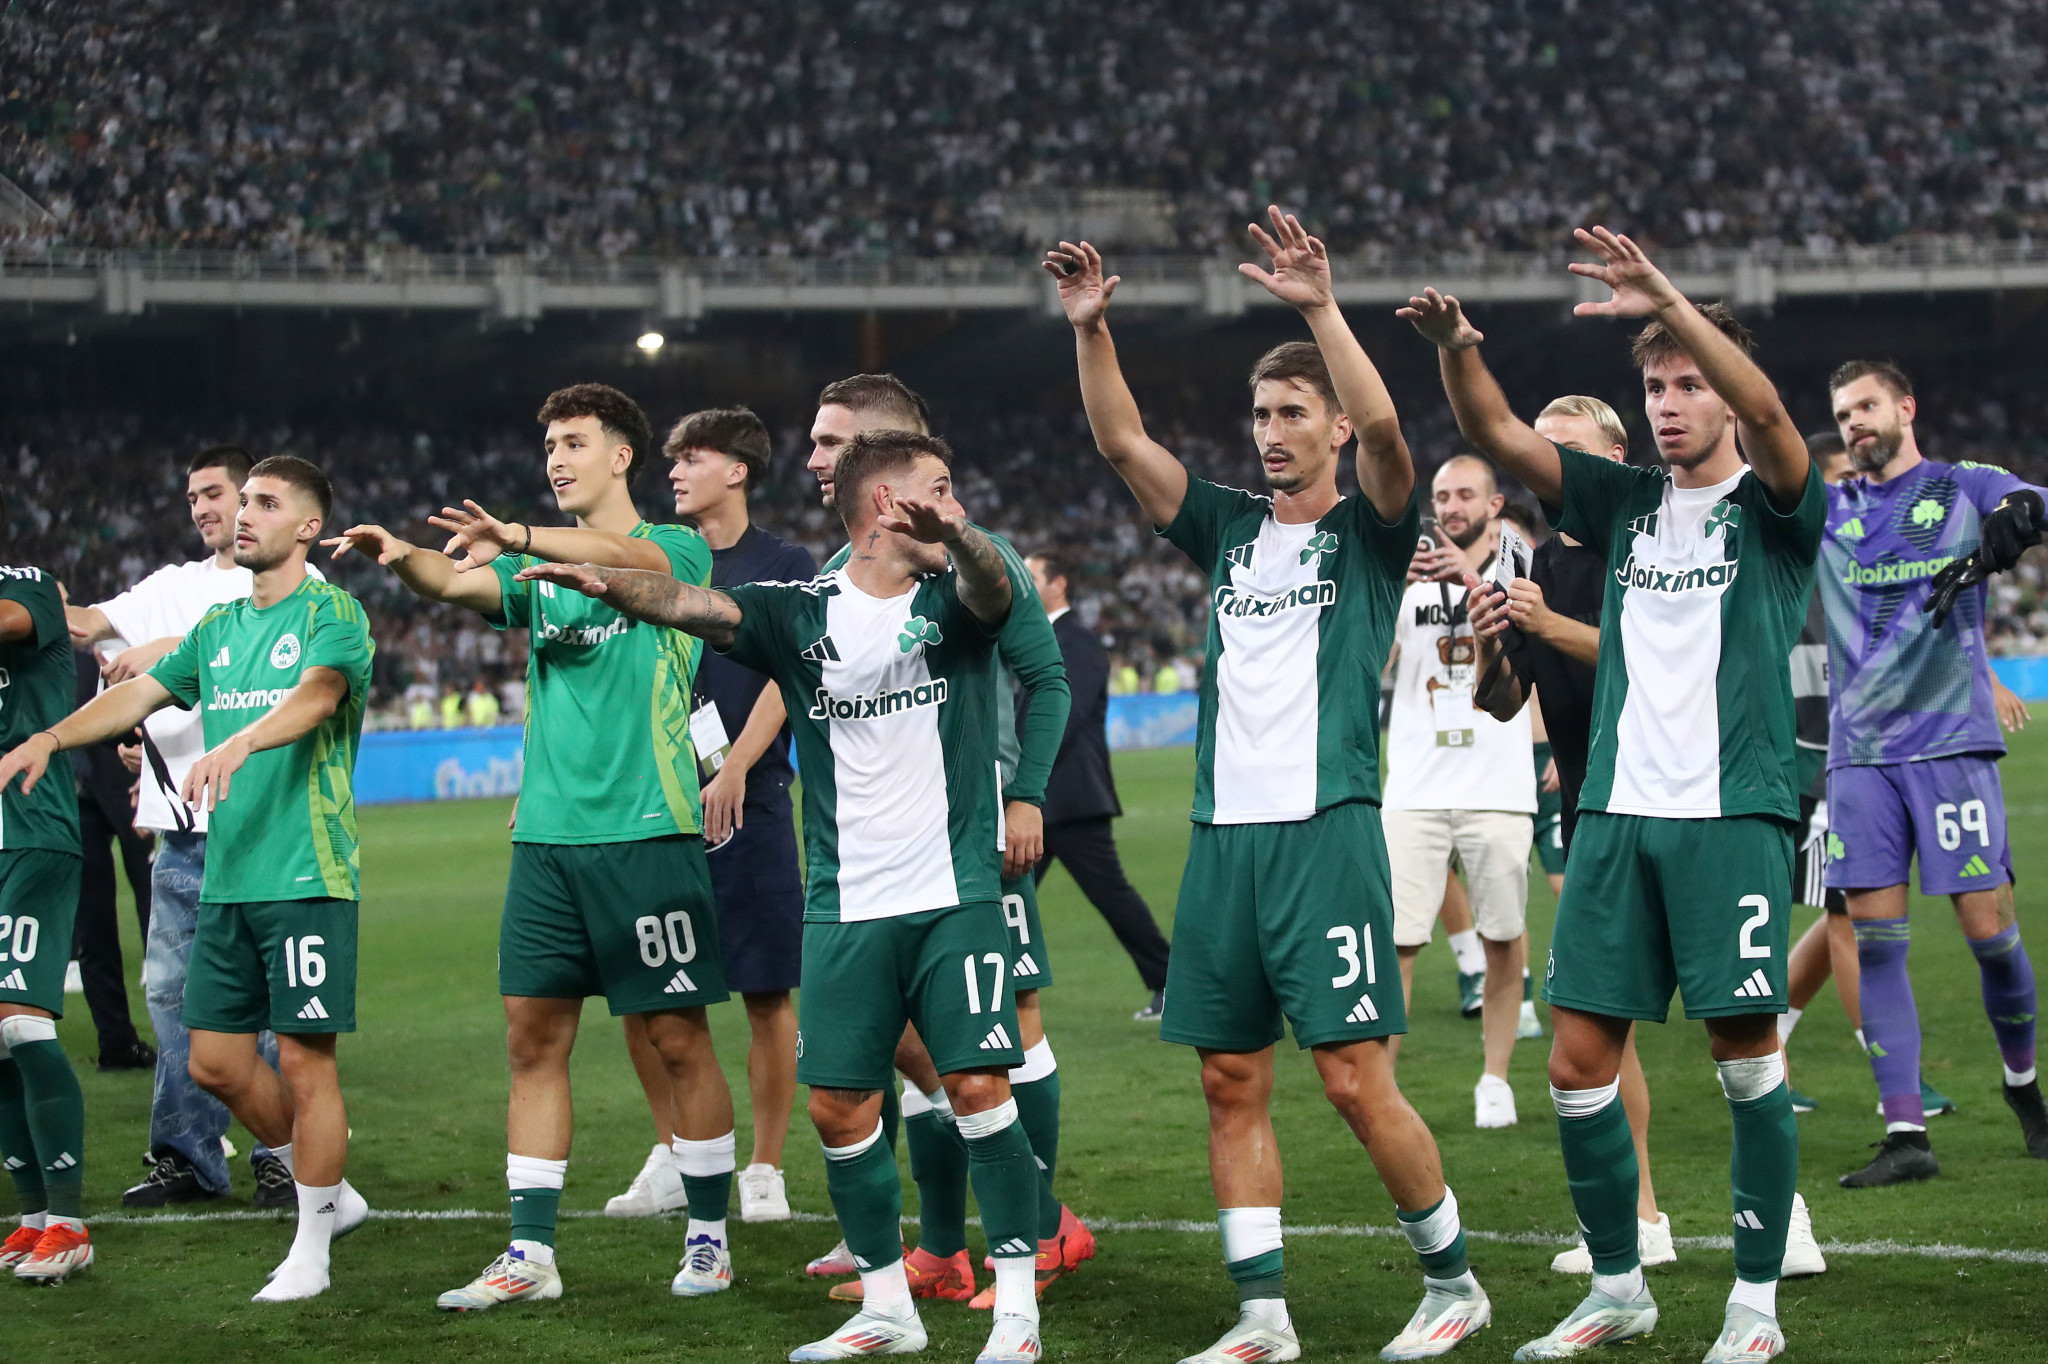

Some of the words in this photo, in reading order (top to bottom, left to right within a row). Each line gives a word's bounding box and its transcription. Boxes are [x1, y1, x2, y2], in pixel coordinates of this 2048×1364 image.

[810, 678, 947, 720] Stoiximan
[1935, 799, 1990, 852] 69
[635, 910, 697, 968] 80
[1326, 922, 1376, 989] 31
[1738, 894, 1771, 959] 2
[285, 935, 327, 988] 16
[964, 952, 1005, 1014] 17
